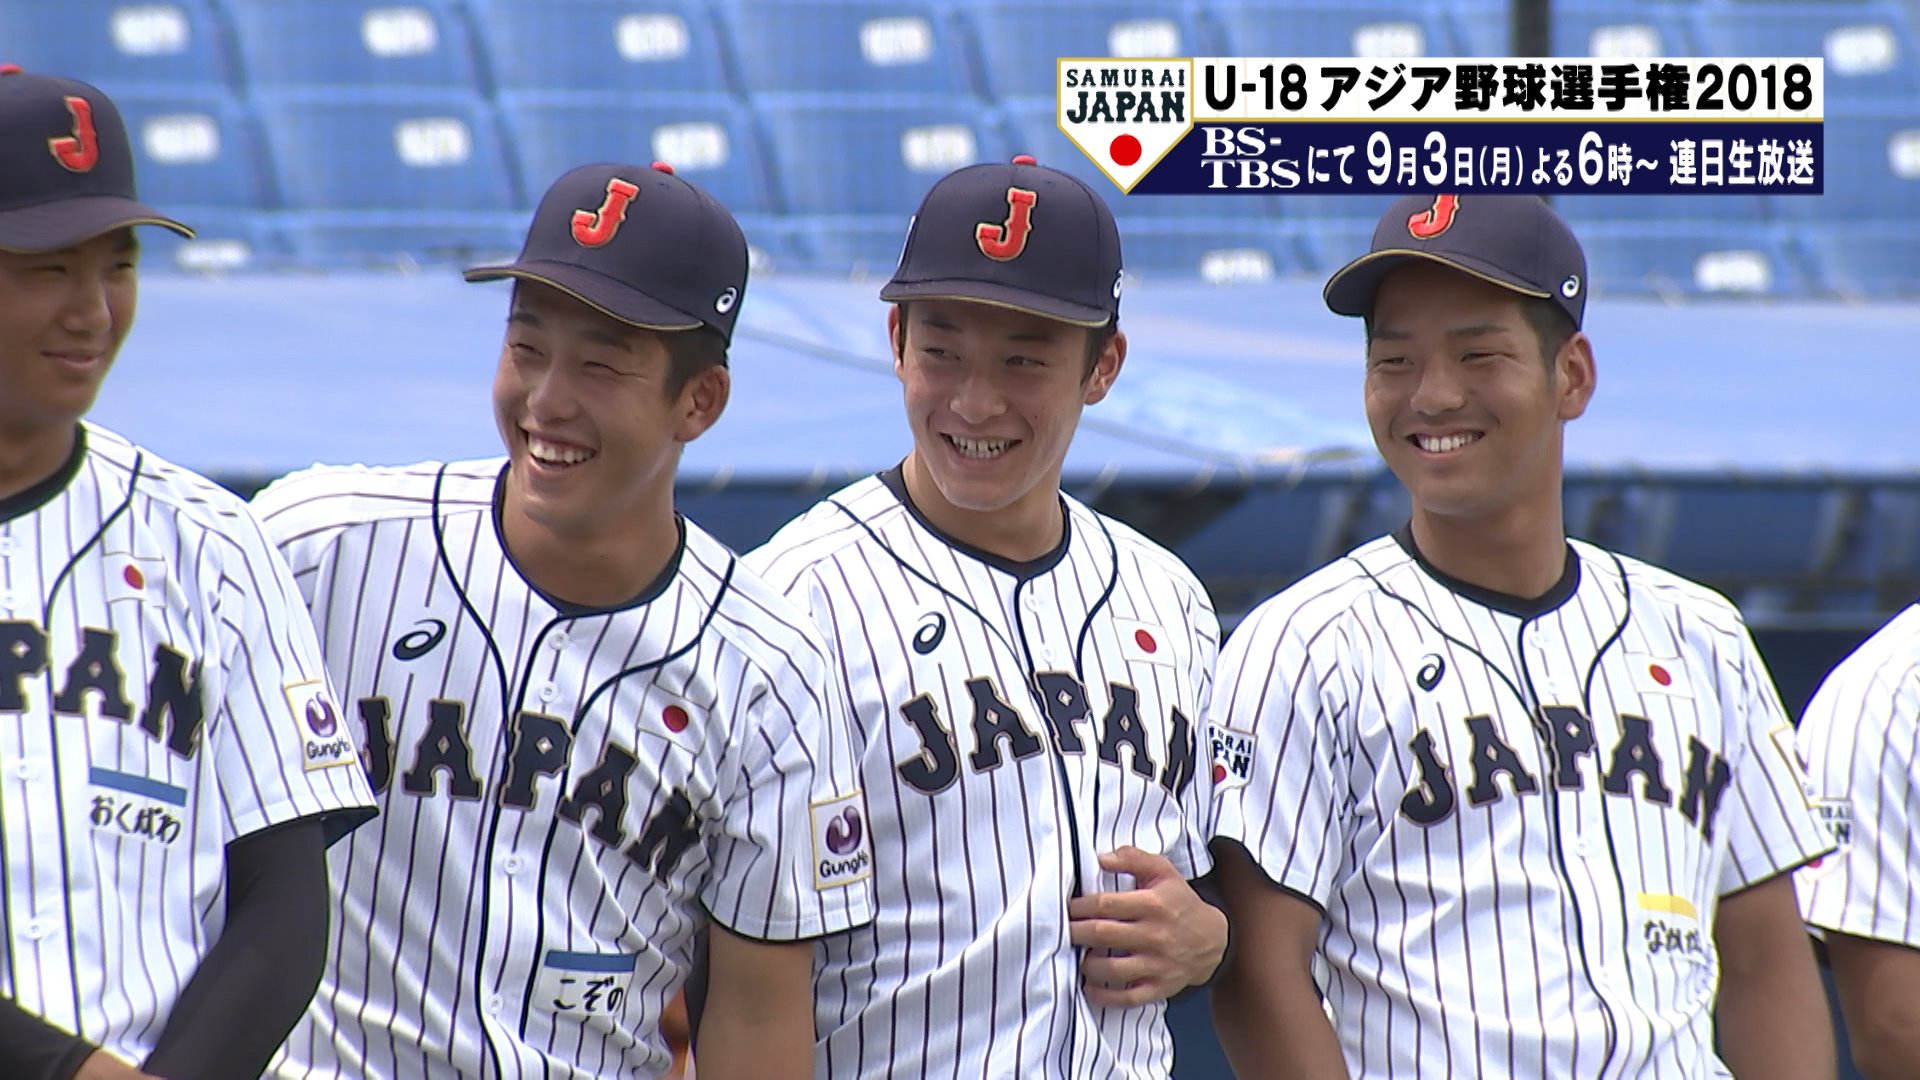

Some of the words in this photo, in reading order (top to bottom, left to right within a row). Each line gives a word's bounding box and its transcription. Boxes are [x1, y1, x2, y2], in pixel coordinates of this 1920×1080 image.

[47, 95, 99, 173] J
[570, 177, 640, 249] J
[975, 186, 1037, 262] J
[1407, 194, 1460, 240] J
[0, 618, 204, 762] PAN
[897, 669, 1197, 813] JAPAN
[1400, 704, 1732, 847] JAPAN
[90, 794, 182, 845] おくがわ
[357, 696, 704, 889] JAPAN
[552, 975, 625, 1013] こぞの
